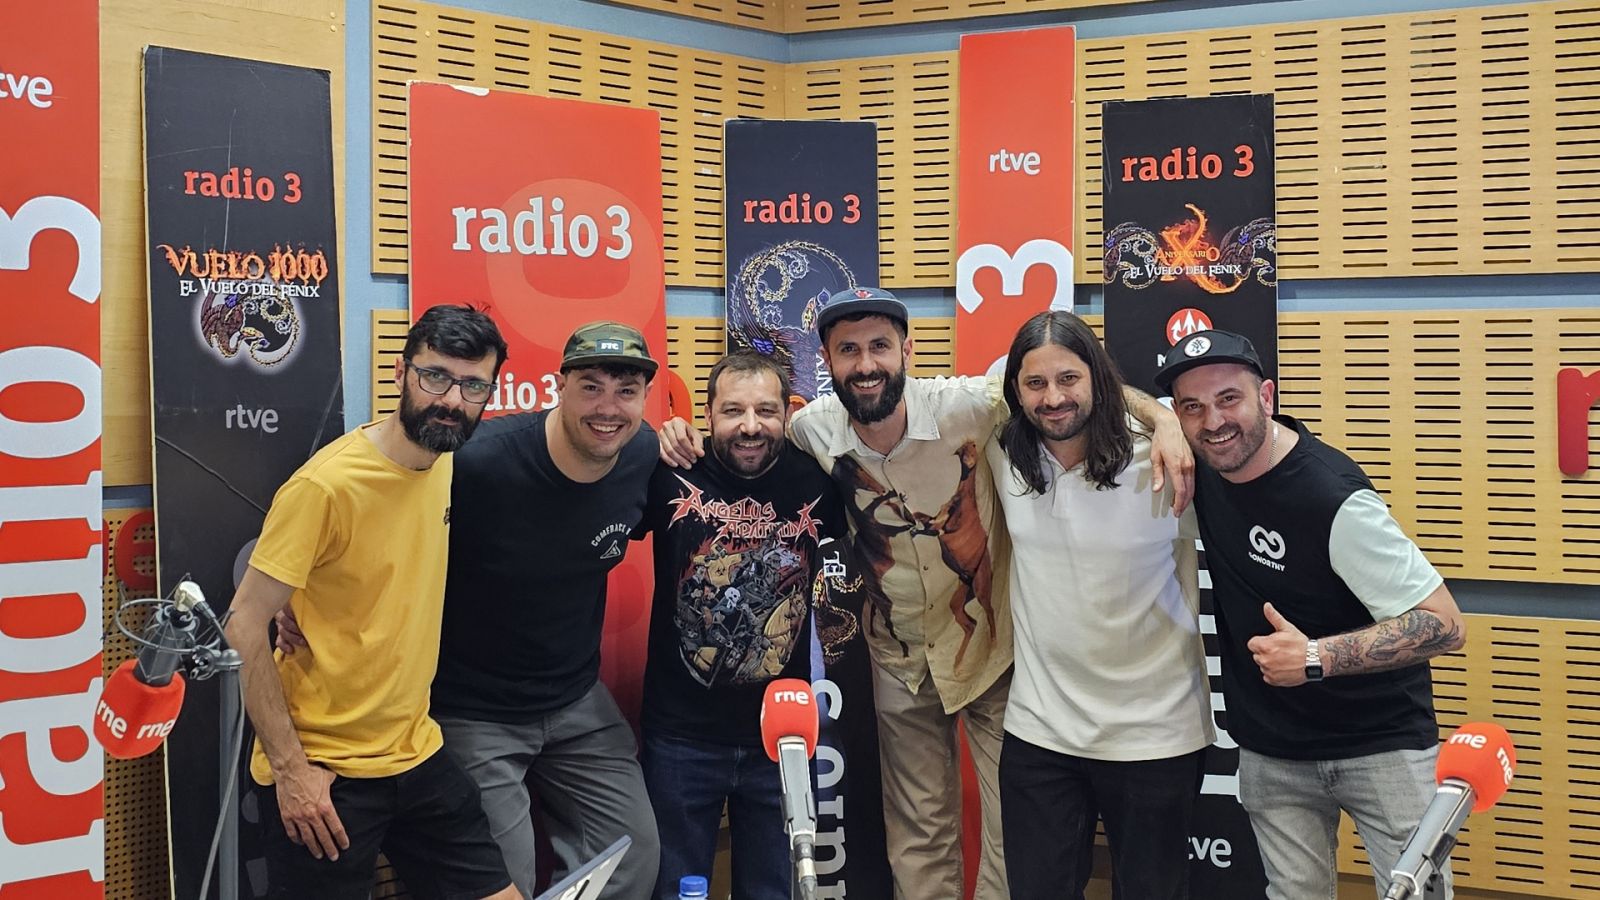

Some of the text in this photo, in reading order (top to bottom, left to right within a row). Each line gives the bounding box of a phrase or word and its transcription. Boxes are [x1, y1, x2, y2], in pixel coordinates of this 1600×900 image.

[989, 149, 1041, 175] rtve
[1121, 145, 1255, 182] radio 3
[184, 167, 302, 203] radio 3
[743, 193, 862, 224] radio 3
[452, 196, 633, 260] radio 3
[156, 244, 328, 287] VUELO 1000
[1130, 262, 1242, 279] EL VUELO DEL FÉNIX
[180, 278, 321, 299] EL VUELO DEL FÉNIX
[541, 374, 560, 410] 3
[225, 405, 279, 433] rtve
[667, 472, 777, 530] ANGELUS
[774, 690, 810, 705] rne
[97, 699, 128, 739] rne
[136, 718, 176, 739] rne
